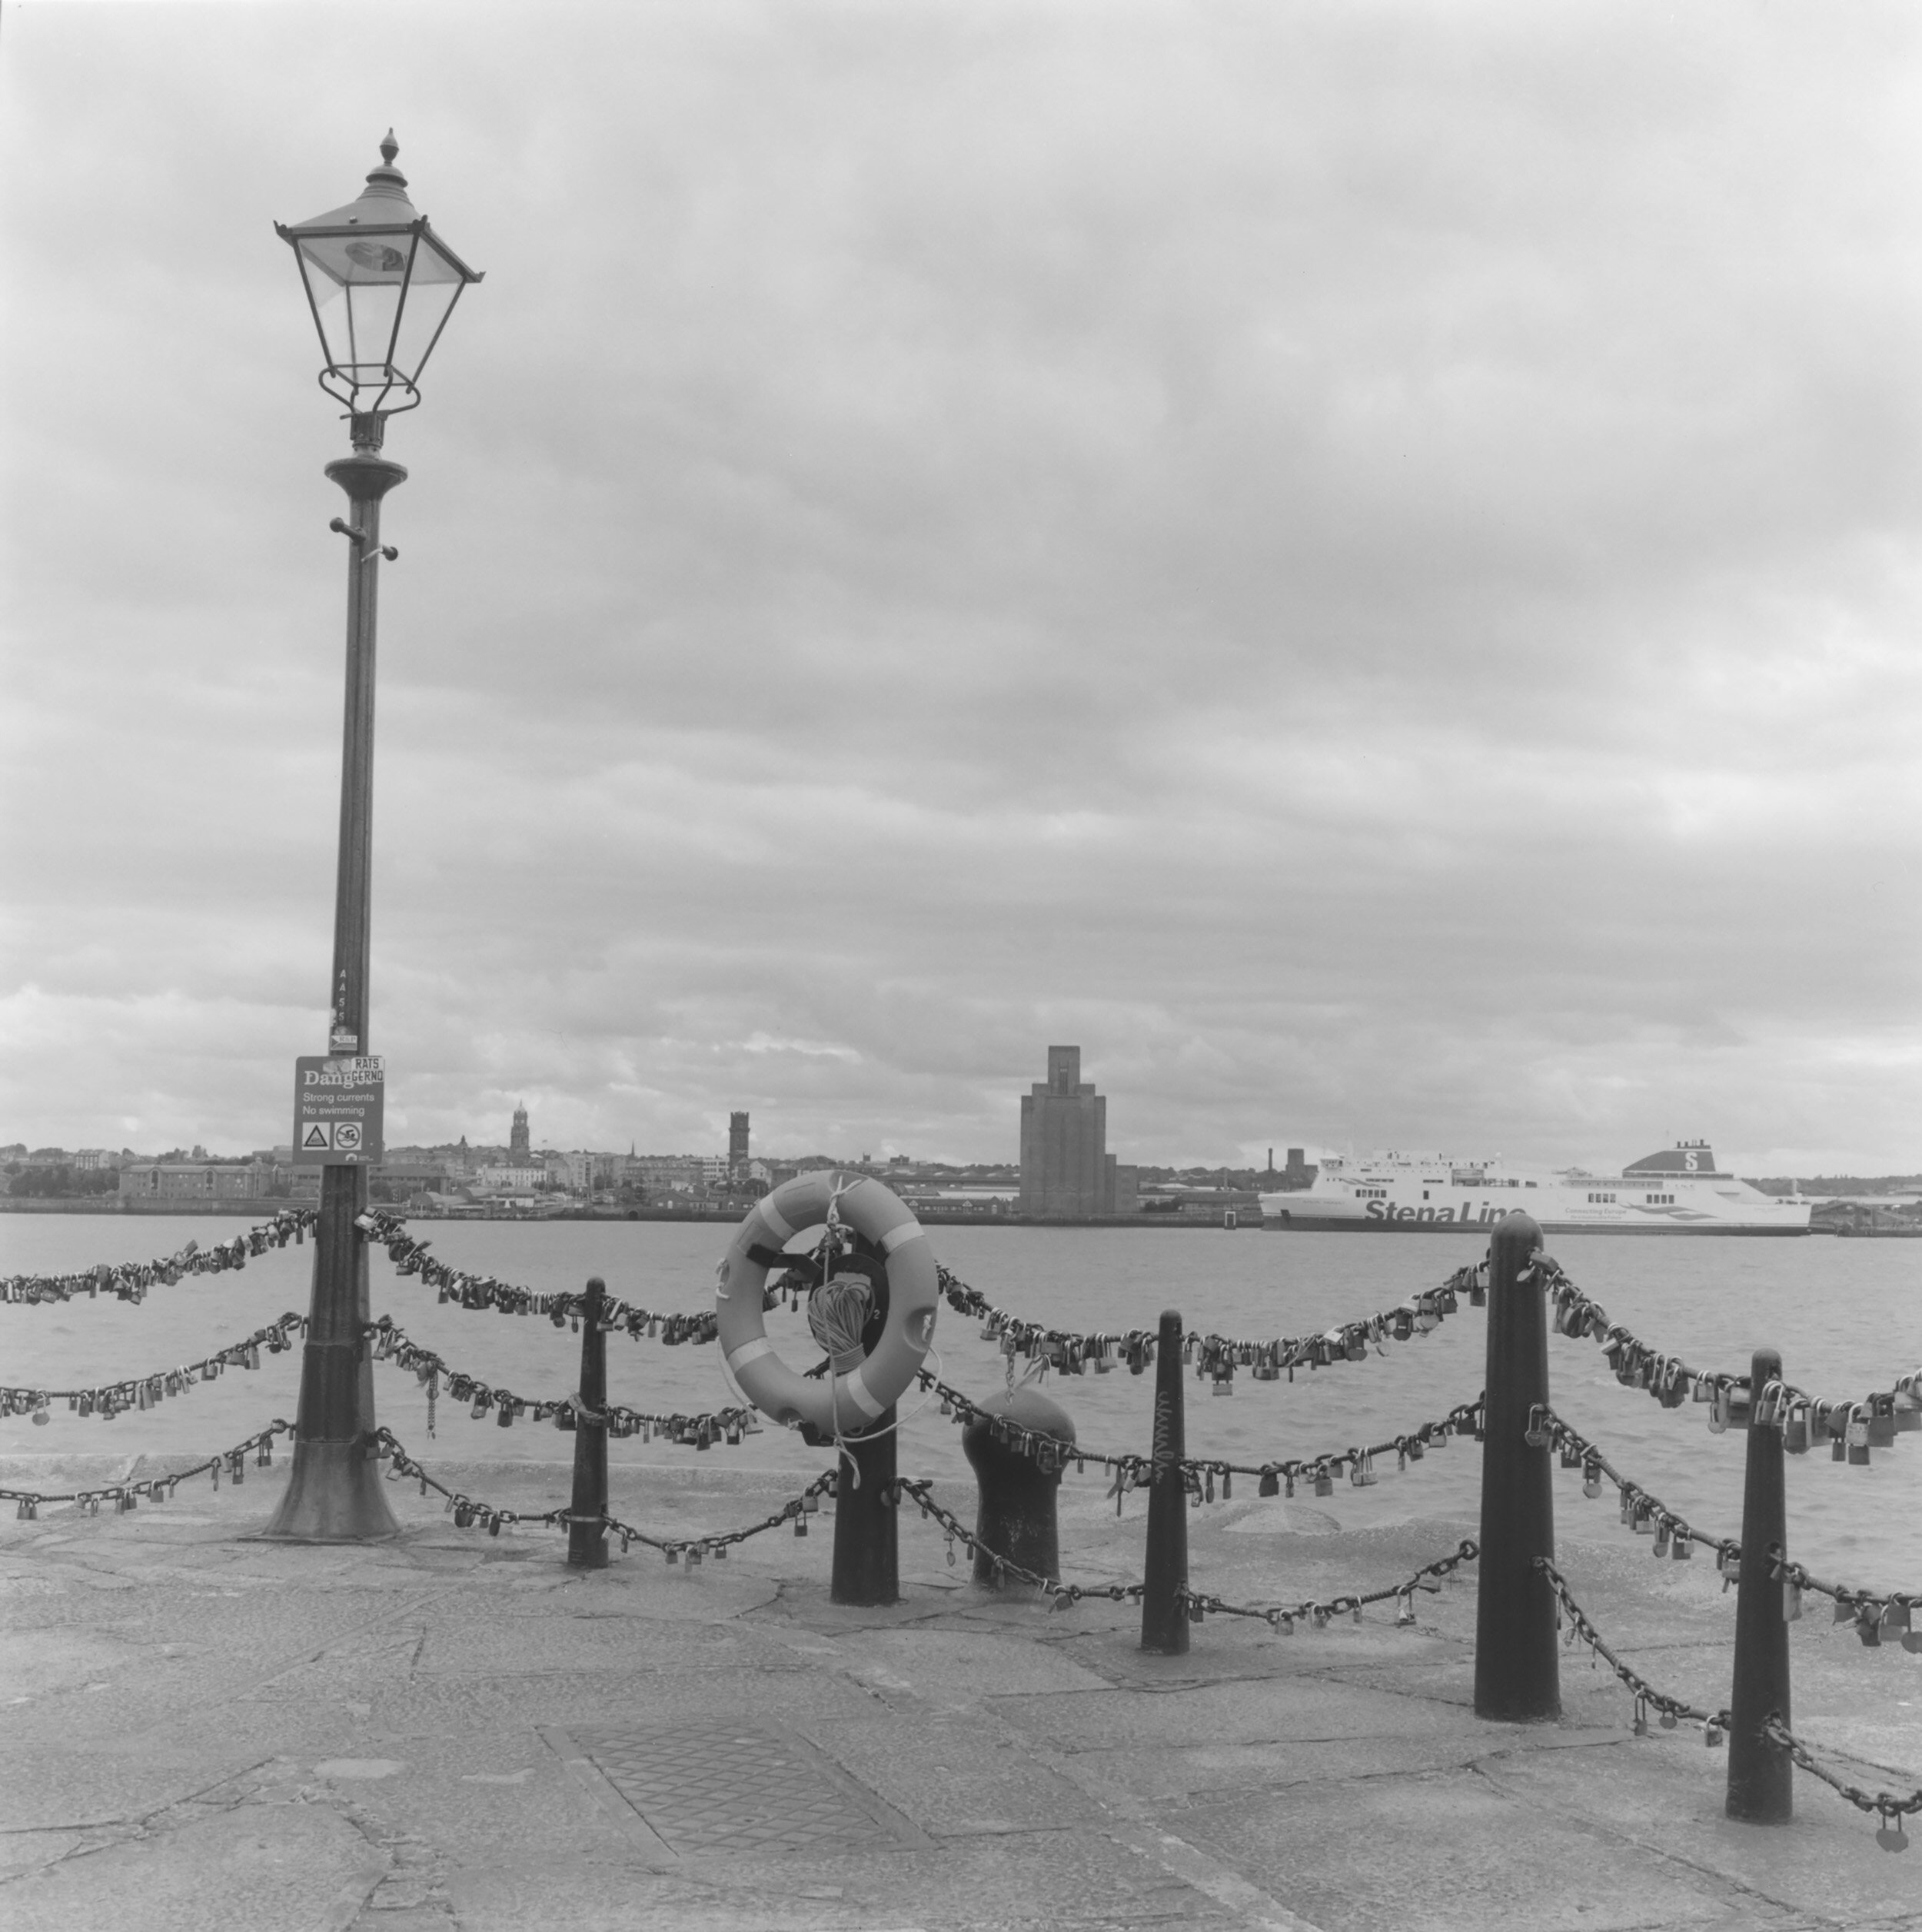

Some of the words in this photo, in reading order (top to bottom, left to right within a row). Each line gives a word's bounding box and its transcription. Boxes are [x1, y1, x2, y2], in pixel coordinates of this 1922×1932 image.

[355, 1058, 379, 1069] RATS
[303, 1092, 334, 1104] Strong
[337, 1093, 375, 1102] currents
[302, 1106, 317, 1115] No
[318, 1106, 365, 1116] swimming
[1365, 1199, 1455, 1222] Stena
[873, 1309, 880, 1319] 2
